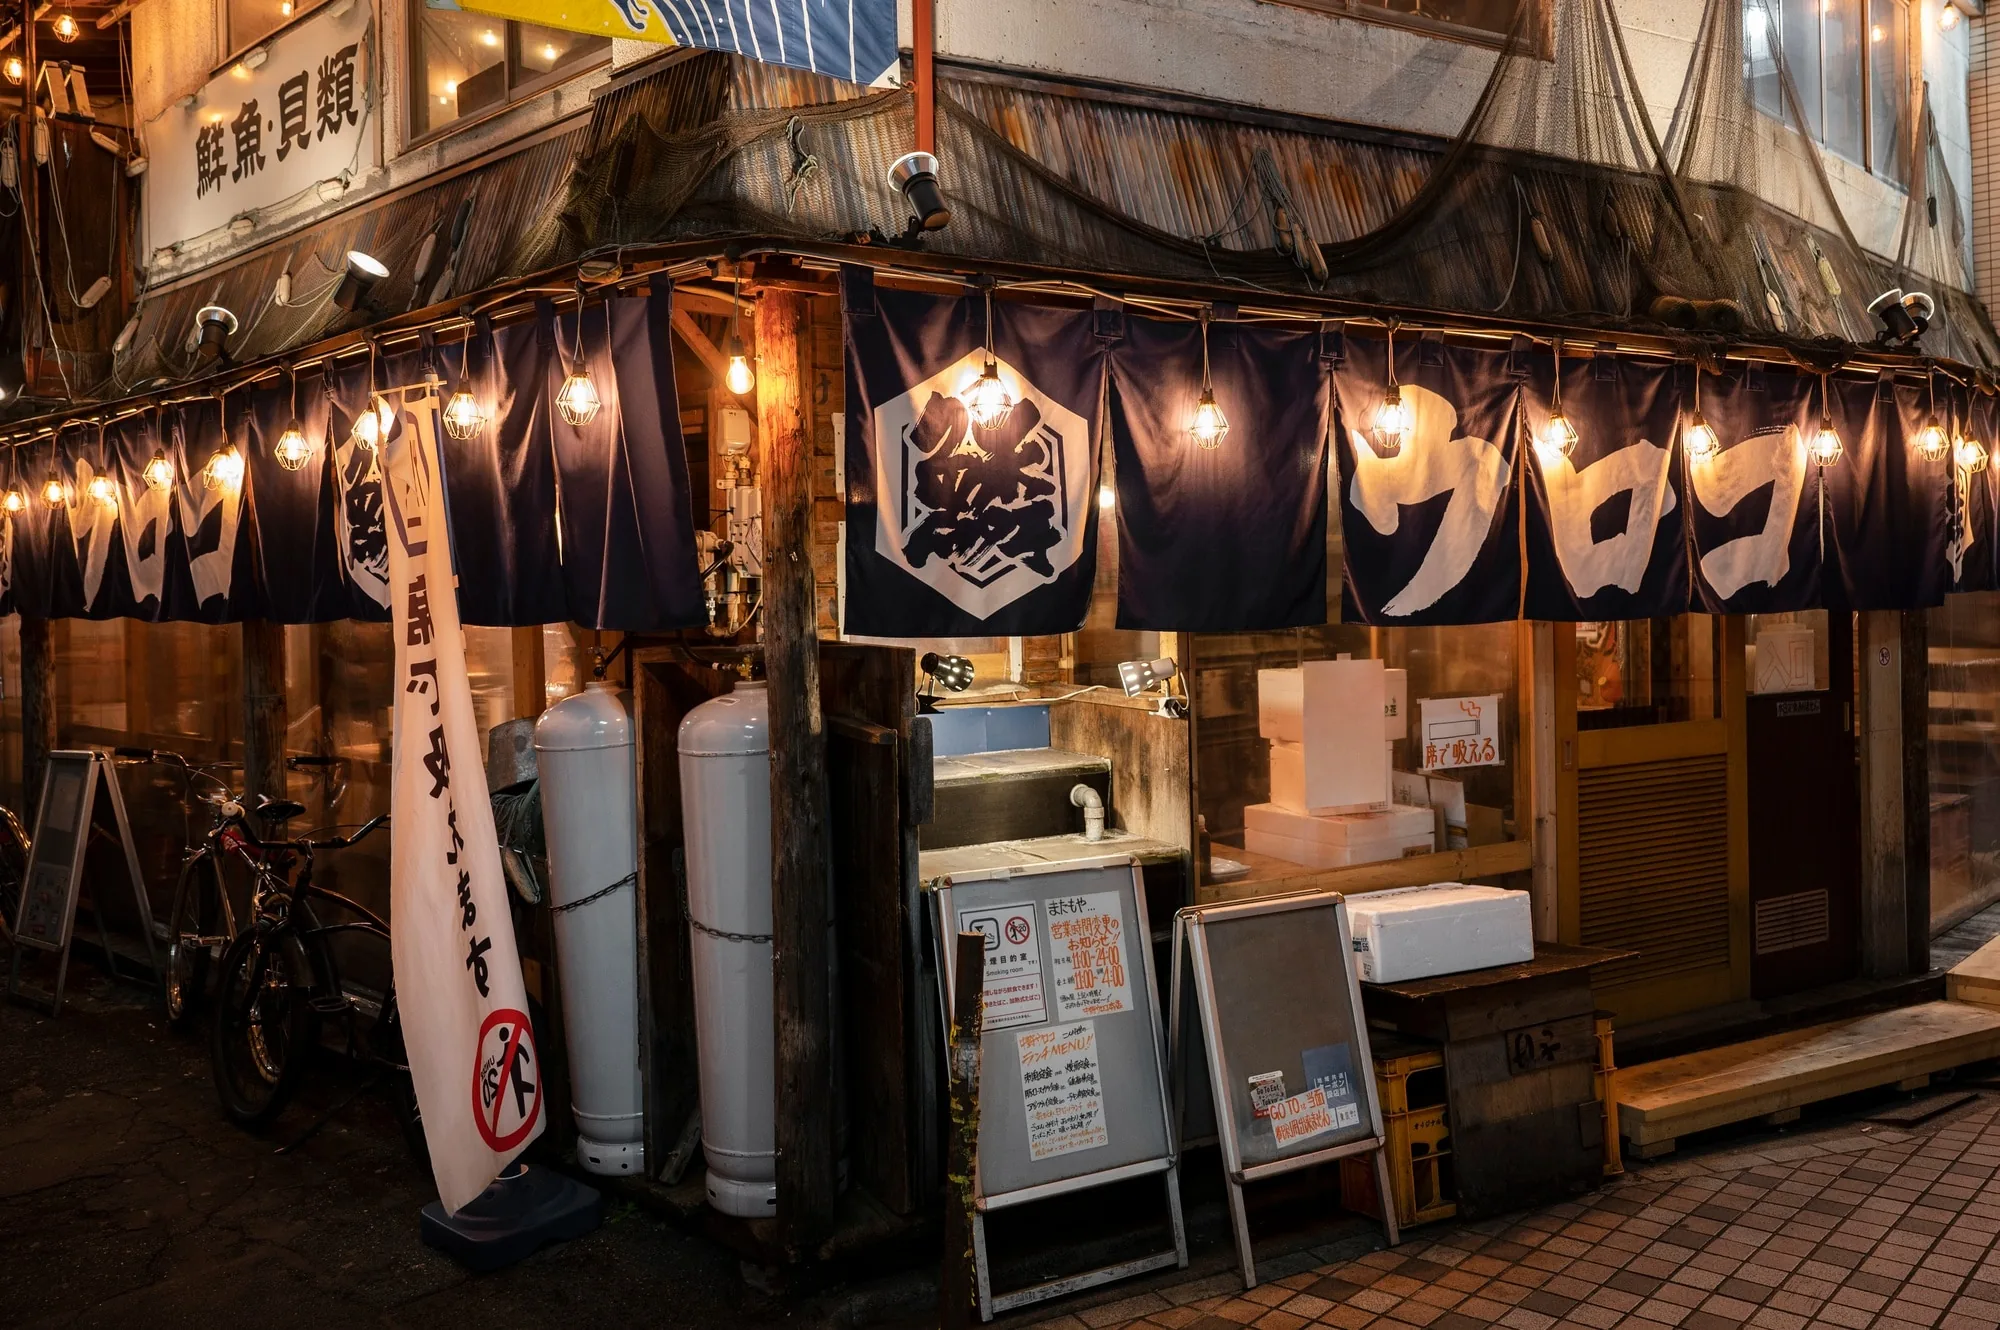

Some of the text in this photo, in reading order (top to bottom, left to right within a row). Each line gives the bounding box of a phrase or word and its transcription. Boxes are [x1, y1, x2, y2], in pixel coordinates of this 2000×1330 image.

[196, 42, 358, 200] 鮮魚・貝類
[1349, 383, 1808, 617] ウロコ
[1758, 640, 1809, 691] 入口
[1425, 736, 1496, 769] 席で吸える
[1051, 914, 1119, 940] 営業時間変更の
[984, 953, 1027, 966] 煙目的室
[986, 968, 1009, 977] Smoking
[984, 983, 1038, 997] 煙しながら飲食できます!
